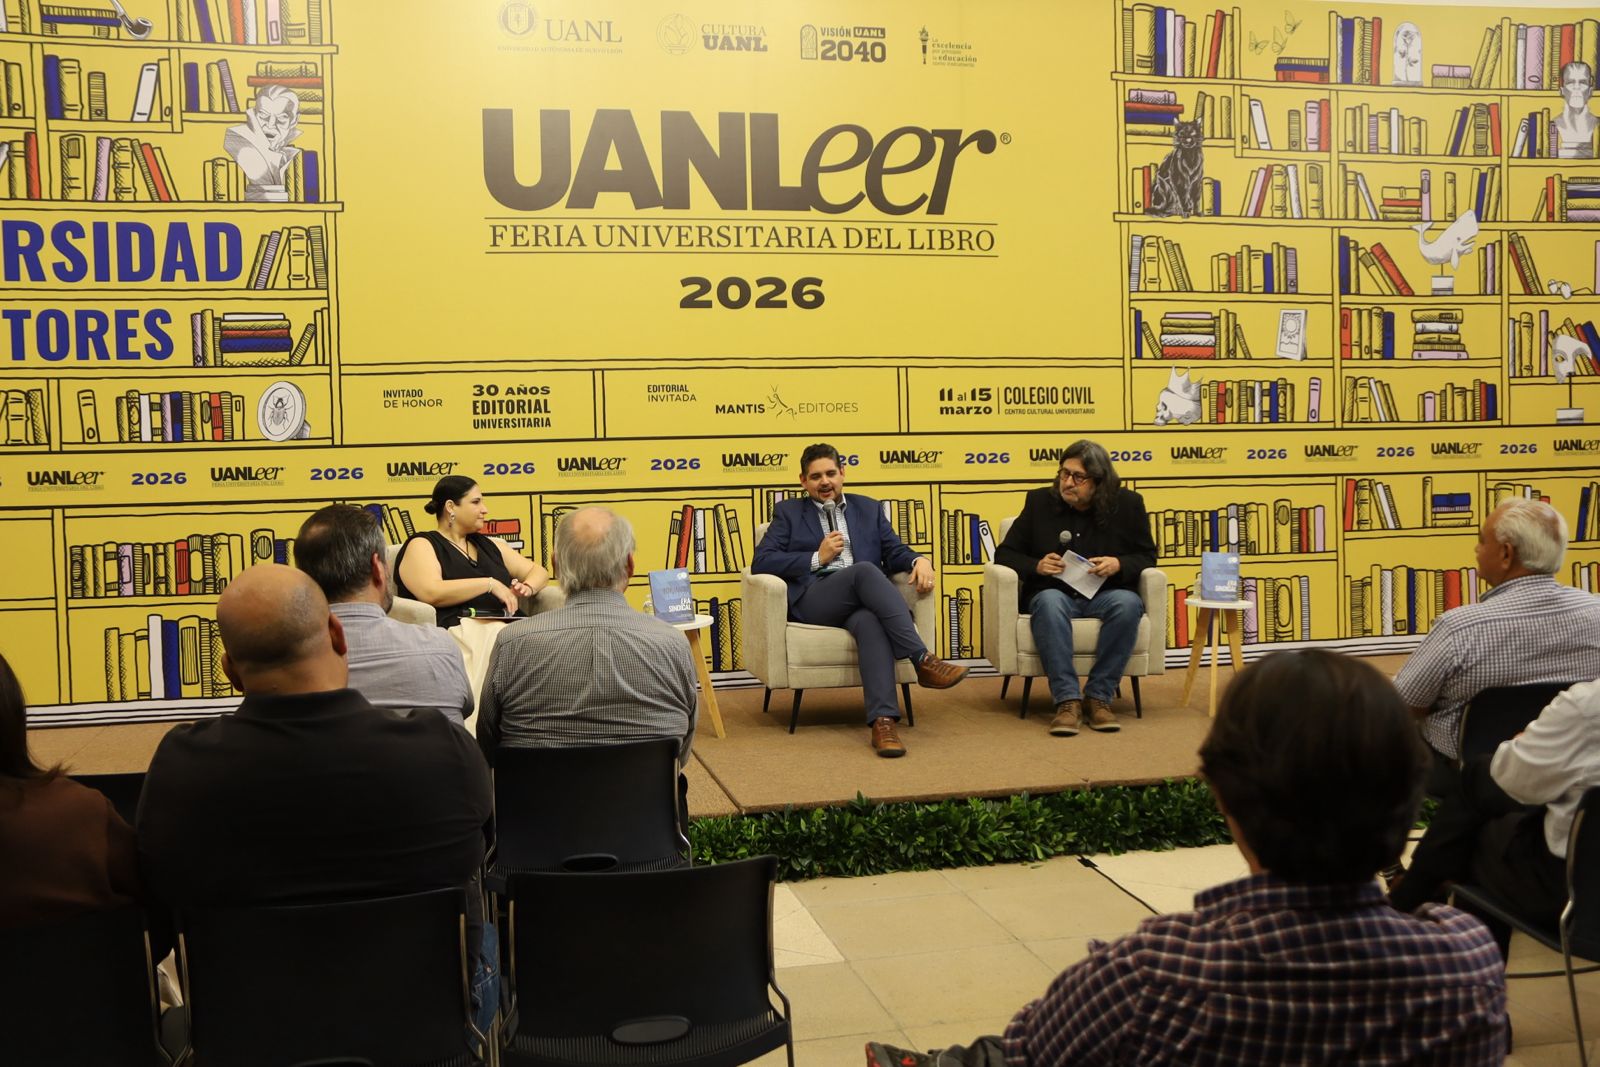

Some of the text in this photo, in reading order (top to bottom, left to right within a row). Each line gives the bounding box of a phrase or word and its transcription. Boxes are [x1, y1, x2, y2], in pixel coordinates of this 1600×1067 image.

[545, 19, 623, 43] UANL
[701, 24, 767, 36] CULTURA
[820, 26, 885, 38] VISIÓN UANL
[702, 35, 768, 52] UANL
[932, 41, 972, 50] excelencia
[820, 40, 887, 63] 2040
[938, 54, 977, 63] educación
[489, 224, 997, 252] FERIA UNIVERSITARIA DEL LIBRO
[2, 220, 243, 282] RSIDAD
[679, 276, 826, 310] 2026
[2, 309, 174, 361] TORES
[383, 389, 423, 398] INVITADO
[472, 383, 551, 397] 30 AÑOS
[647, 384, 689, 393] EDITORIAL
[939, 388, 992, 401] 11 al 15
[648, 394, 697, 402] INVITADA
[1004, 387, 1095, 405] COLEGIO CIVIL
[384, 399, 443, 408] DE HONOR
[472, 399, 551, 415] EDITORIAL
[715, 402, 859, 414] MANTIS EDITORES
[939, 405, 993, 415] marzo
[473, 417, 551, 429] UNIVERSITARIA
[27, 471, 105, 486] UANLeer
[131, 472, 187, 485] 2026
[210, 466, 285, 482] UANLeer
[310, 467, 364, 480] 2026
[387, 462, 458, 476] UANLeer
[483, 462, 535, 475] 2026
[557, 457, 627, 471] UANLeer
[650, 458, 700, 470] 2026
[722, 453, 788, 467] UANLeer
[838, 454, 860, 466] 26
[879, 450, 943, 464] UANLeer
[964, 452, 1010, 464] 2026
[1110, 450, 1152, 461] 2026
[1171, 446, 1227, 459] UANLeer
[1247, 448, 1287, 459] 2026
[1304, 445, 1358, 457] UANLeer
[1377, 446, 1414, 457] 2026
[1431, 442, 1482, 455] UANLeer
[1500, 443, 1537, 454] 2026
